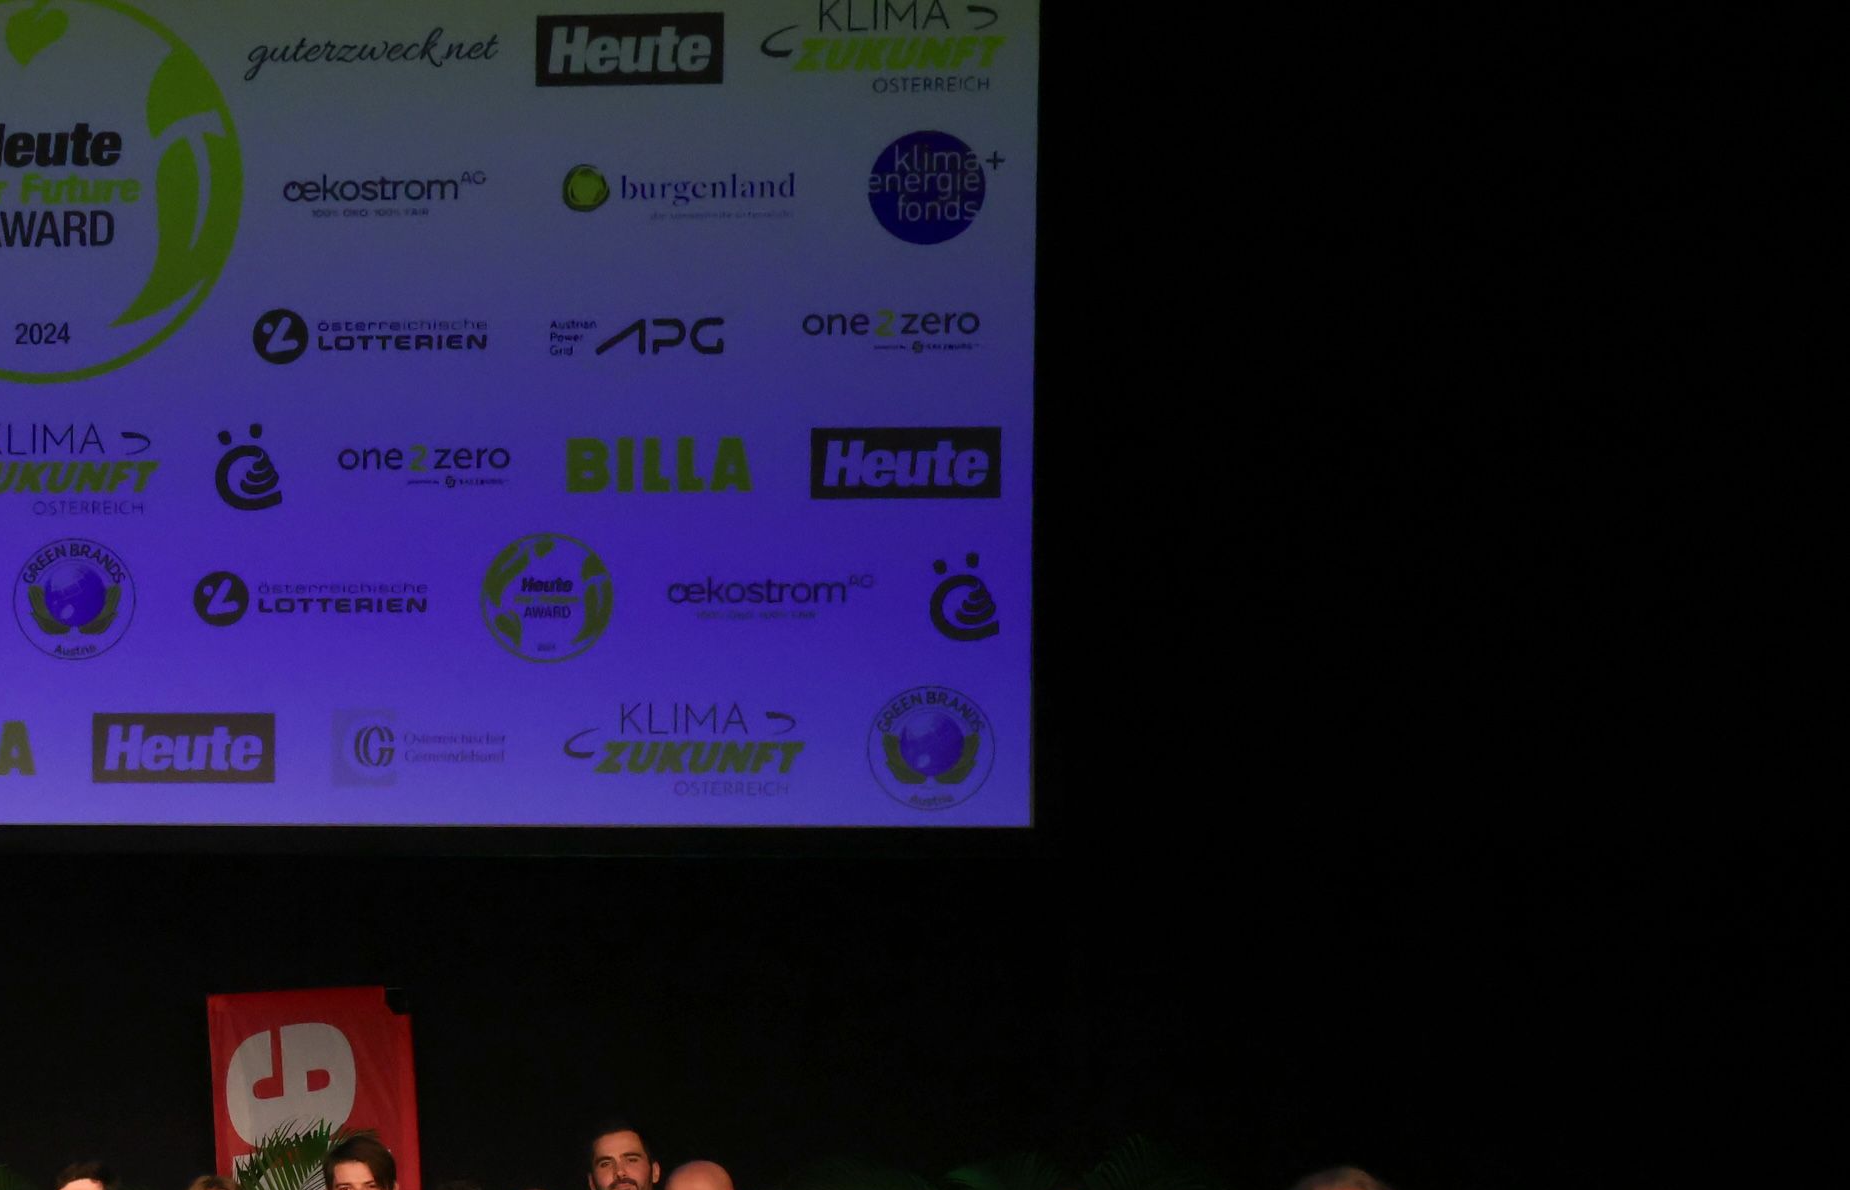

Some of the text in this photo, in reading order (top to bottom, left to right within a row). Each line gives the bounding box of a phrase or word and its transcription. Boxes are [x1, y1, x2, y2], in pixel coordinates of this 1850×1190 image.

[819, 0, 950, 31] KLIMA
[244, 27, 500, 81] guterzweck.net
[548, 25, 713, 75] Heute
[793, 36, 1007, 71] ZUKUNFT
[894, 143, 979, 171] klima
[21, 174, 142, 204] Future
[621, 171, 796, 206] burgenland
[867, 172, 981, 202] energie
[897, 196, 980, 222] fonds
[14, 322, 71, 345] 2024
[317, 318, 488, 332] österreichische
[595, 316, 726, 355] APG
[317, 333, 489, 352] LOTTERIEN
[565, 435, 754, 494] BILLA
[822, 439, 990, 488] Heute
[22, 542, 126, 586] GREEN BRANDS
[520, 576, 574, 593] Heute
[257, 597, 428, 614] LOTTERIEN
[522, 605, 572, 620] AWARD
[53, 642, 98, 657] Austria
[619, 700, 749, 735] KLIMA
[876, 690, 986, 734] GREEN BRANDS
[103, 724, 264, 772] Heute
[594, 740, 806, 774] ZUKUNFT
